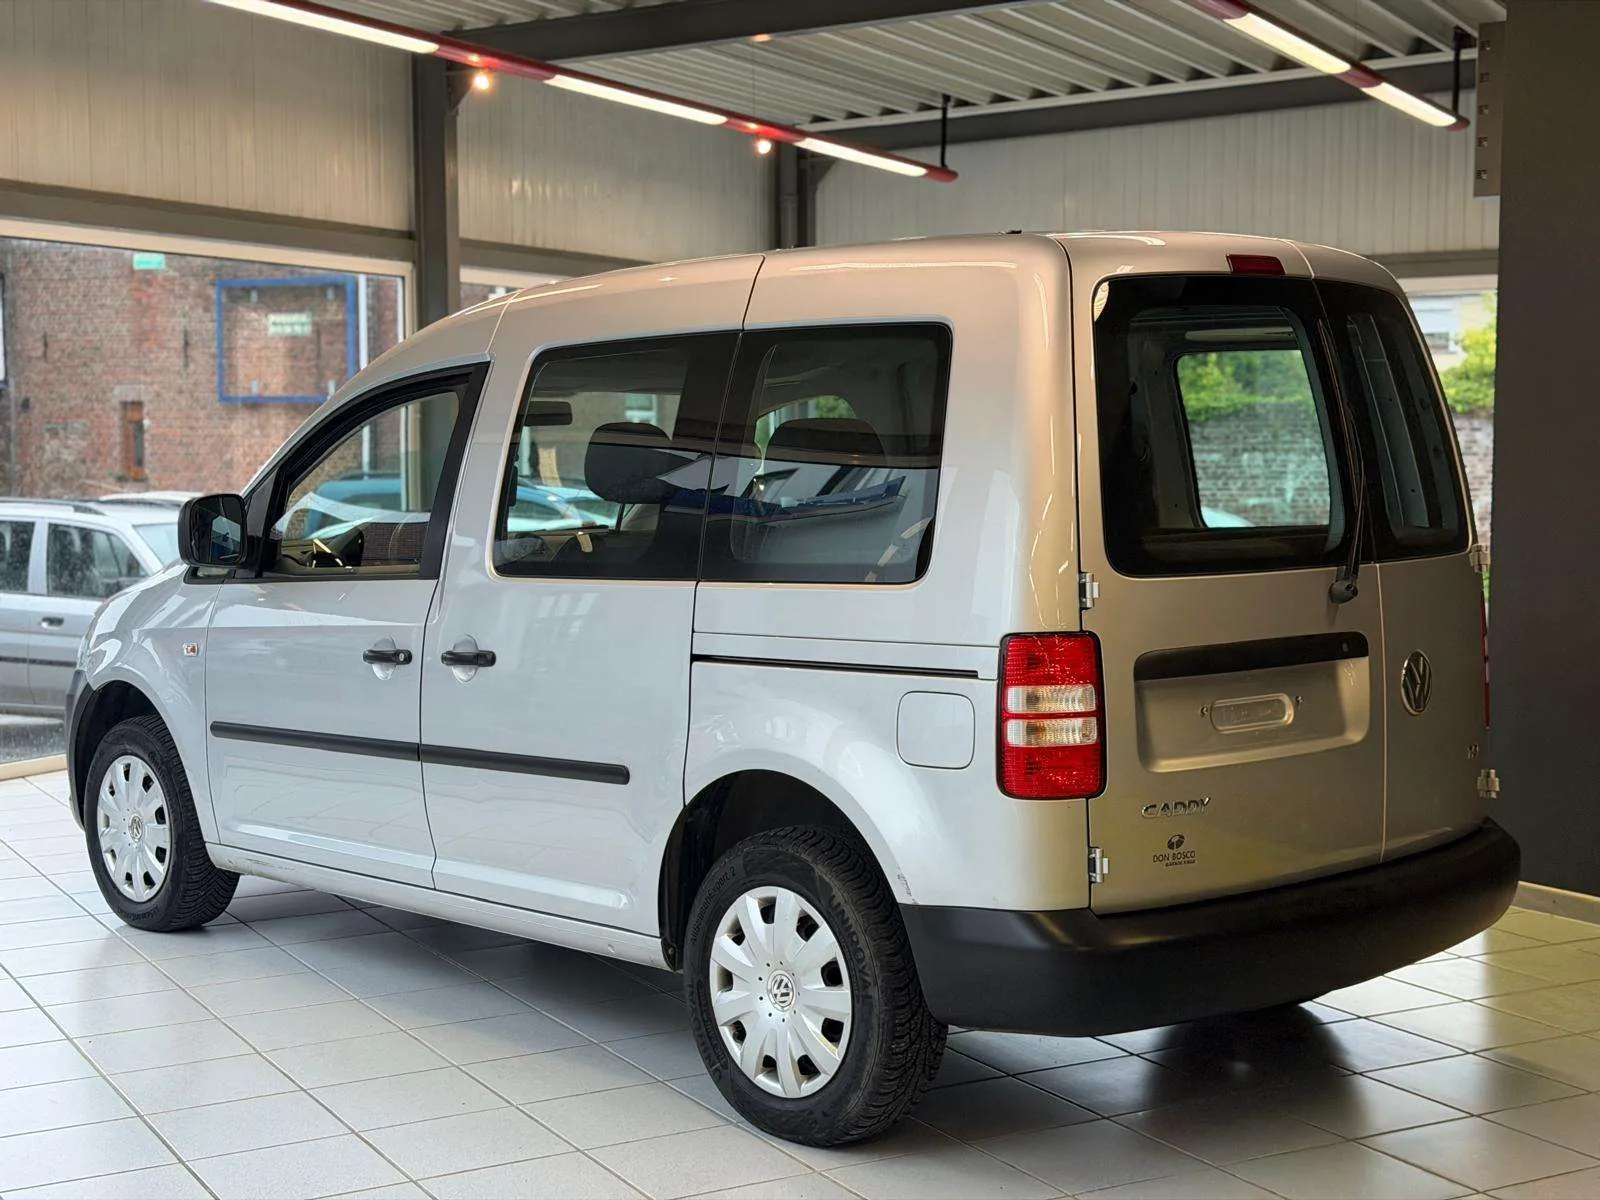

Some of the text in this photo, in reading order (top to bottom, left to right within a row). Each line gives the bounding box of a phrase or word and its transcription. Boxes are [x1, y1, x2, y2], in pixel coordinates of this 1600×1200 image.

[1141, 796, 1211, 819] CADDY
[1152, 850, 1196, 862] DON BOSCO
